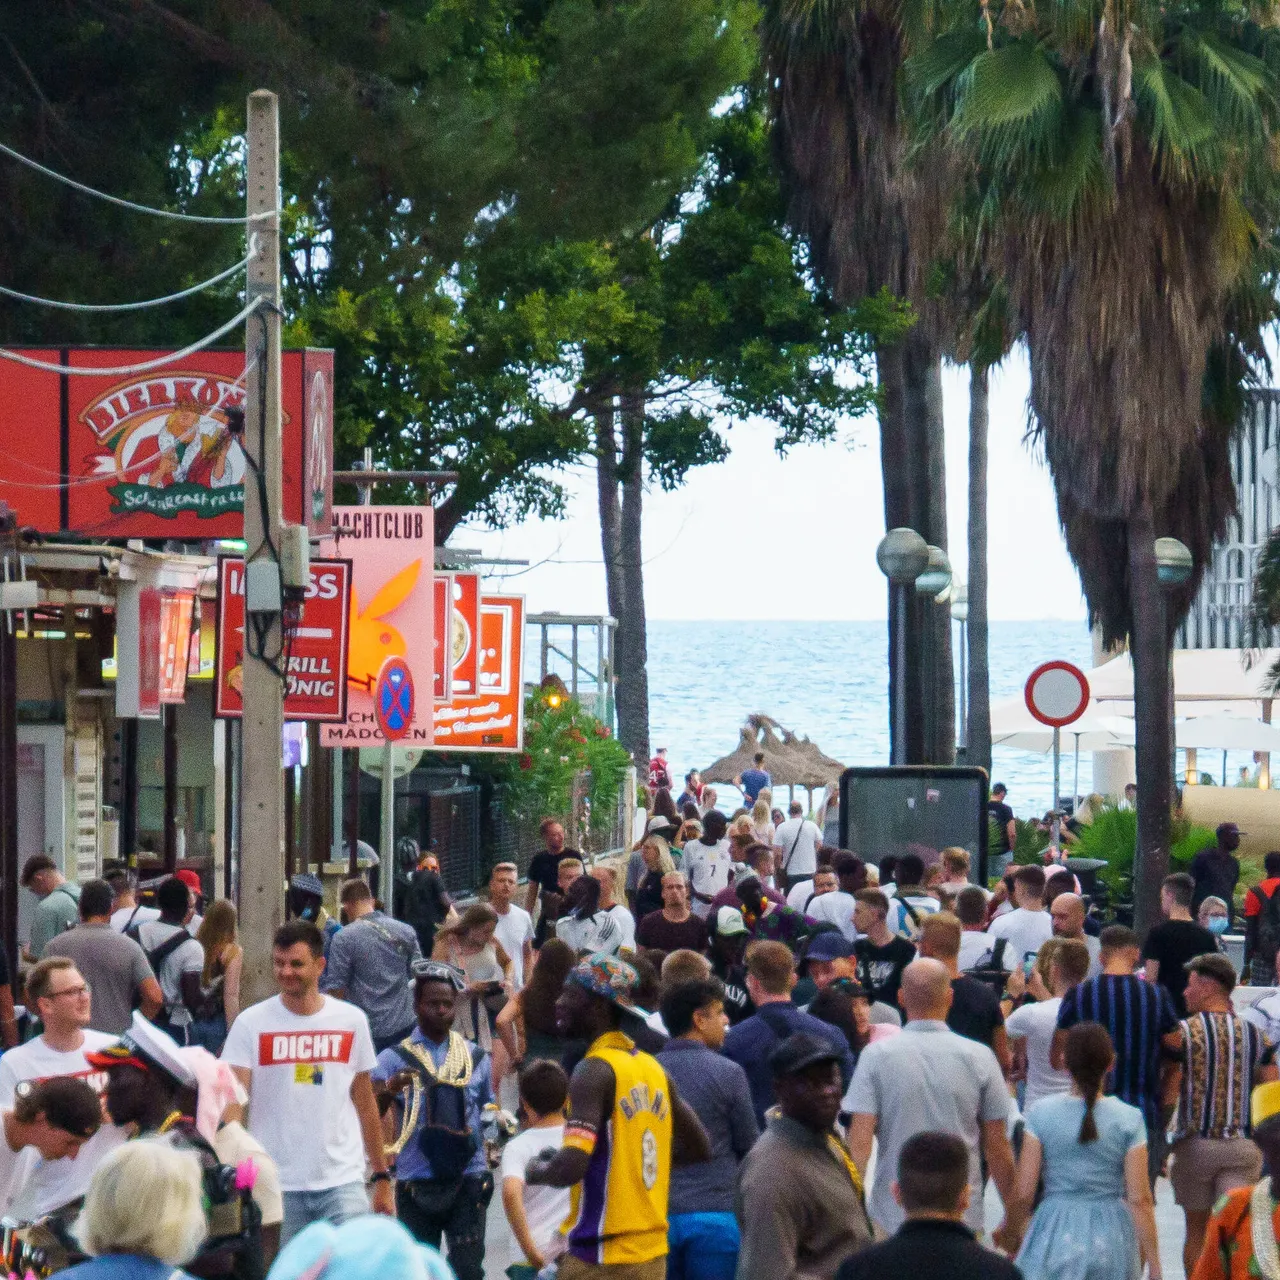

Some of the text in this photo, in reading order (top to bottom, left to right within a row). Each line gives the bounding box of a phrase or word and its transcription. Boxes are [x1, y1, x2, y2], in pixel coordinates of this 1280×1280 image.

[86, 377, 247, 434] BIERKÖN
[332, 513, 423, 540] NACHTCLUB
[287, 656, 332, 674] RILL
[286, 675, 335, 697] ÖNIG
[328, 726, 427, 740] MÄDCEN
[272, 1034, 343, 1061] DICHT
